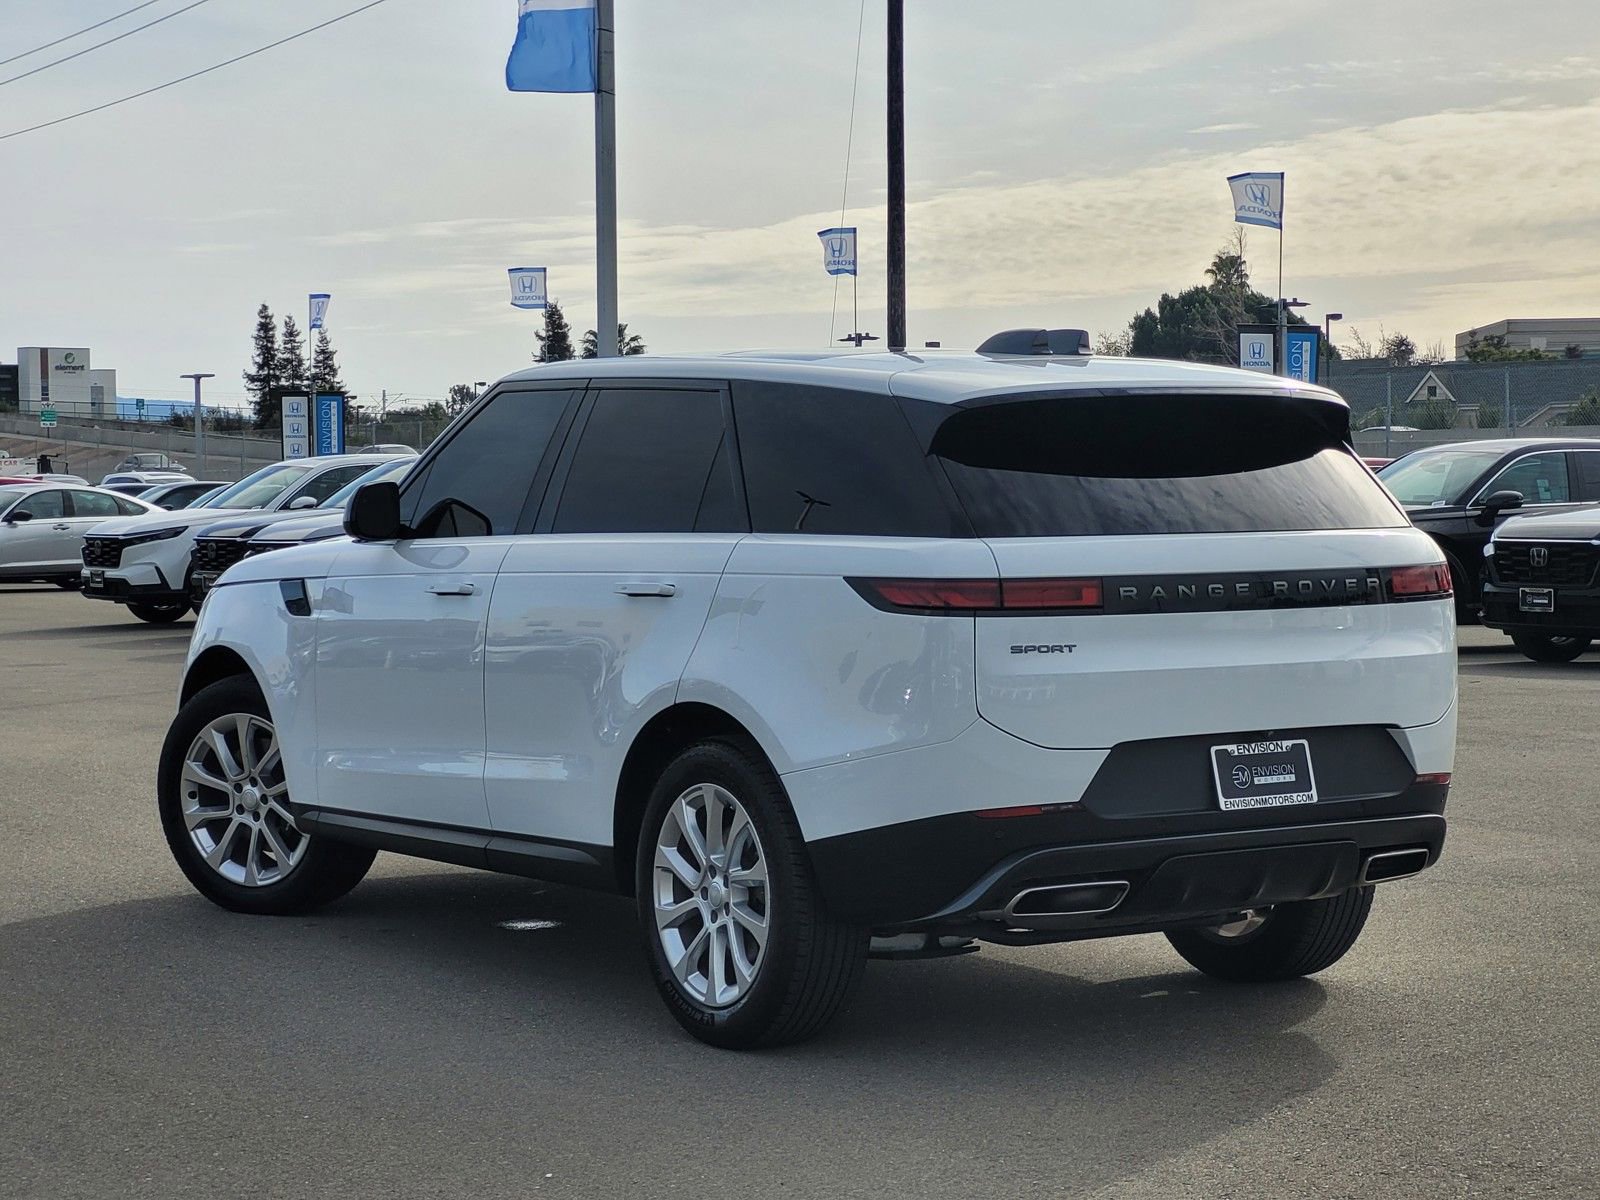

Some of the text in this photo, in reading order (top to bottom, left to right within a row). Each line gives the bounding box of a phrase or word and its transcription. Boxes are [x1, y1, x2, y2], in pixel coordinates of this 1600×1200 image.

[54, 363, 85, 371] element
[321, 400, 331, 454] ENVISION
[1119, 577, 1380, 601] RANGE ROVER
[1010, 643, 1077, 655] SPORT
[1236, 741, 1284, 754] ENVISION
[1252, 764, 1295, 776] ENVISION
[1224, 794, 1314, 809] ENVISIONMOTORS.COM
